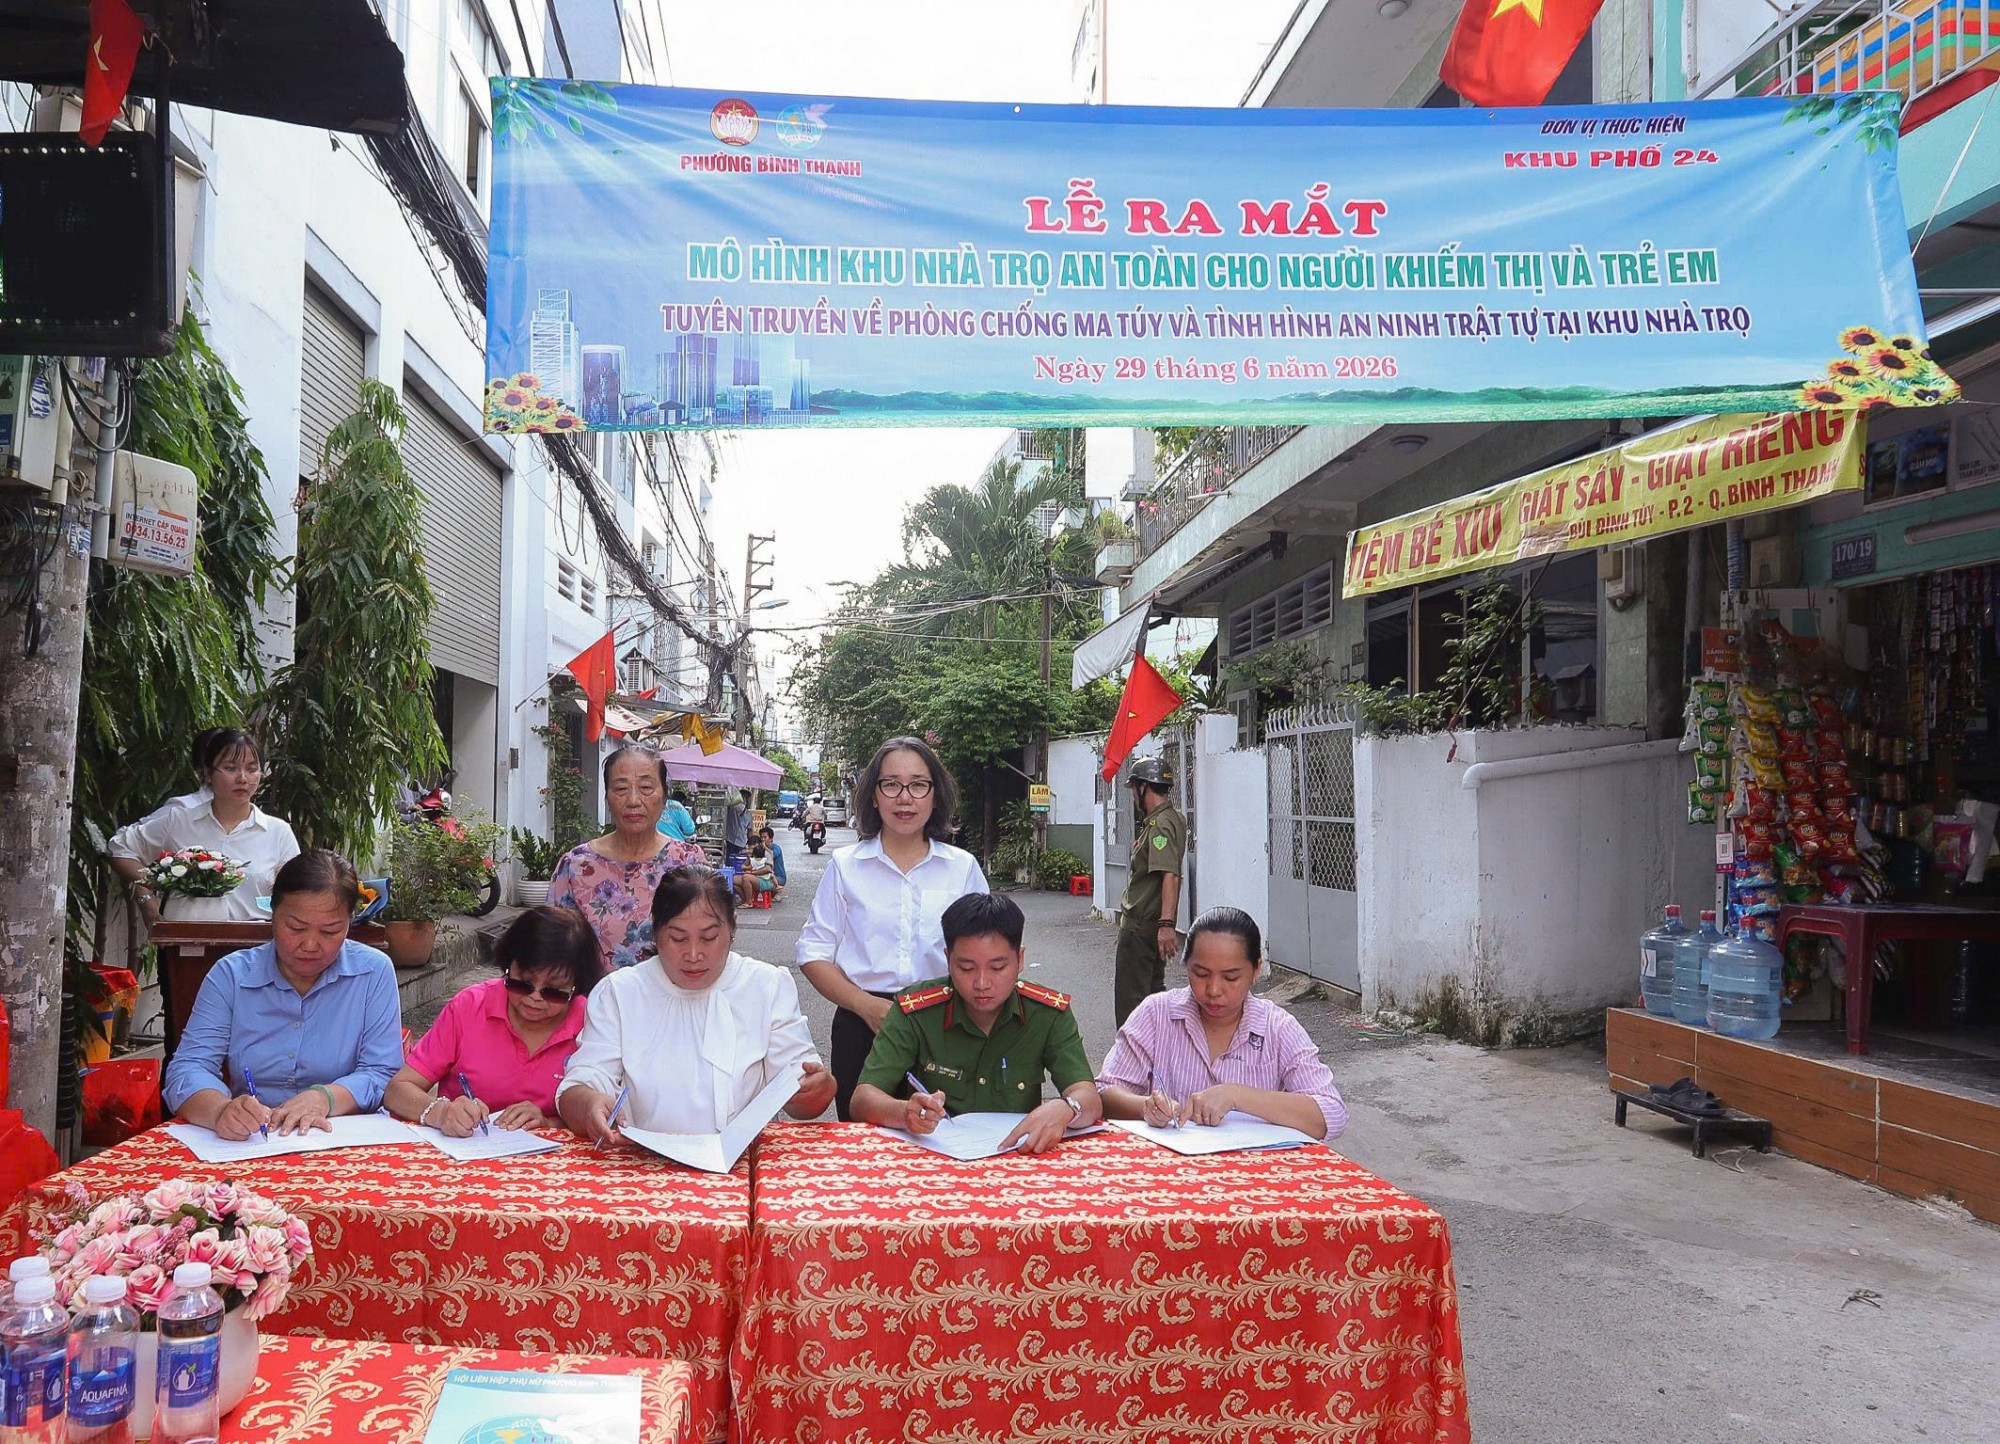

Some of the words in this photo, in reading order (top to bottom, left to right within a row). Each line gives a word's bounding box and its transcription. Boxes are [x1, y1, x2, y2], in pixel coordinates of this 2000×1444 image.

[1541, 119, 1577, 135] ĐƠN
[1580, 119, 1596, 138] VỊ
[1600, 118, 1641, 138] THỰC
[1646, 115, 1686, 136] HIỆN
[681, 152, 752, 172] PHƯỜNG
[757, 154, 799, 173] BÌNH
[804, 160, 862, 178] THẠNH
[1504, 151, 1577, 168] KHU
[1590, 143, 1667, 168] PHỐ
[1673, 149, 1720, 166] 24
[1024, 178, 1108, 234] LỄ
[1125, 198, 1224, 235] RA
[1240, 182, 1388, 237] MẮT
[687, 236, 742, 282] MÔ
[750, 237, 830, 284] HÌNH
[838, 245, 905, 286] KHU
[912, 239, 984, 288] NHÀ
[990, 249, 1051, 295] TRỌ
[1060, 251, 1105, 290] AN
[1113, 246, 1198, 291] TOÀN
[1206, 252, 1271, 290] CHO
[1278, 246, 1375, 290] NGƯỜI
[1384, 241, 1486, 289] KHIẾM
[1494, 252, 1545, 296] THỊ
[1550, 245, 1595, 289] VÀ
[1600, 240, 1661, 288] TRẺ
[1667, 247, 1719, 285] EM
[662, 299, 743, 334] TUYÊN
[749, 297, 846, 336] TRUYỀN
[852, 297, 883, 335] VỀ
[889, 302, 975, 337] PHÒNG
[982, 300, 1068, 338] CHỐNG
[1073, 313, 1113, 338] MA
[1116, 306, 1167, 339] TÚY
[1169, 307, 1201, 338] VÀ
[1205, 306, 1263, 338] TÌNH
[1268, 306, 1333, 338] HÌNH
[1337, 313, 1372, 338] AN
[1377, 312, 1440, 337] NINH
[1444, 307, 1506, 343] TRẬT
[1508, 308, 1540, 344] TỰ
[1544, 311, 1582, 342] TẠI
[1587, 307, 1640, 335] KHU
[1645, 301, 1699, 334] NHÀ
[1702, 306, 1751, 339] TRỌ
[1034, 356, 1107, 384] Ngày
[1114, 357, 1147, 379] 29
[1154, 355, 1238, 383] tháng
[1243, 357, 1258, 379] 6
[1266, 356, 1329, 378] năm
[1334, 356, 1397, 379] 2026
[1347, 531, 1404, 587] TIỆM
[1410, 511, 1443, 569] BÉ
[1452, 499, 1503, 559] XÍU
[1518, 480, 1569, 527] GIẶT
[1574, 456, 1625, 510] SẤY
[1647, 435, 1716, 491] GIẶT
[1722, 411, 1845, 470] RIÊNG
[125, 513, 156, 526] INTERNET
[157, 520, 169, 530] CÁP
[170, 524, 189, 536] QUANG
[1633, 503, 1656, 527] TÚY
[125, 522, 186, 549] 0934.13.56.23
[1836, 540, 1872, 563] 170/19
[81, 1382, 128, 1403] AQUAFINA
[453, 1375, 469, 1384] HỘI
[470, 1375, 488, 1384] LIÊN
[489, 1376, 509, 1385] HIỆP
[510, 1377, 527, 1387] PHỤ
[528, 1378, 542, 1387] NỮ
